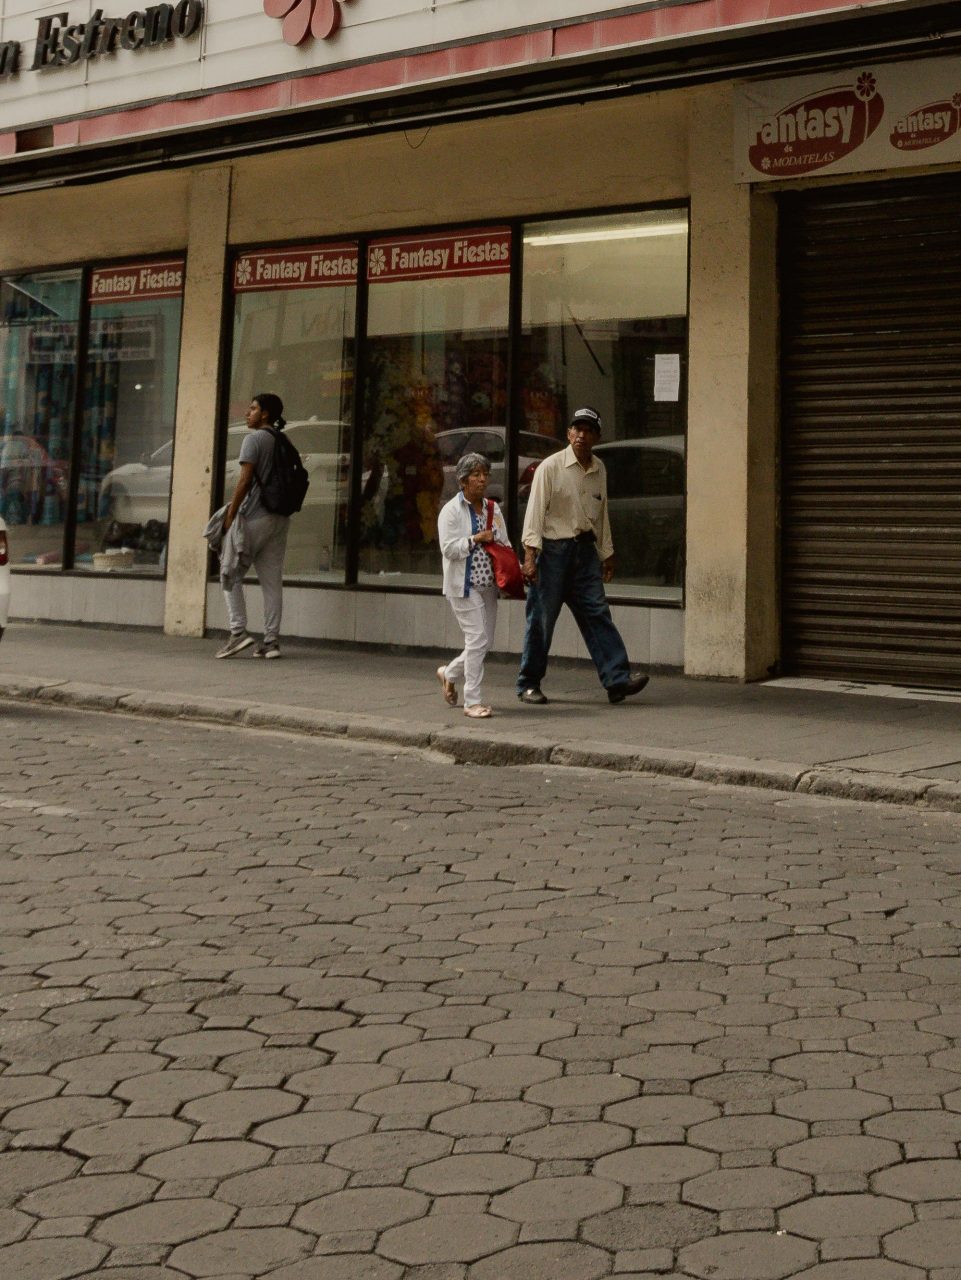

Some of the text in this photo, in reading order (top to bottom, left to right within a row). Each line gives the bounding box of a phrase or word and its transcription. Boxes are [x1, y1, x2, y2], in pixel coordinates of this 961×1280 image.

[772, 151, 835, 169] MODATELAS
[255, 254, 358, 281] Fantasy Fiestas
[391, 240, 509, 272] Fantasy Fiestas
[91, 268, 182, 294] Fantasy Fiestas
